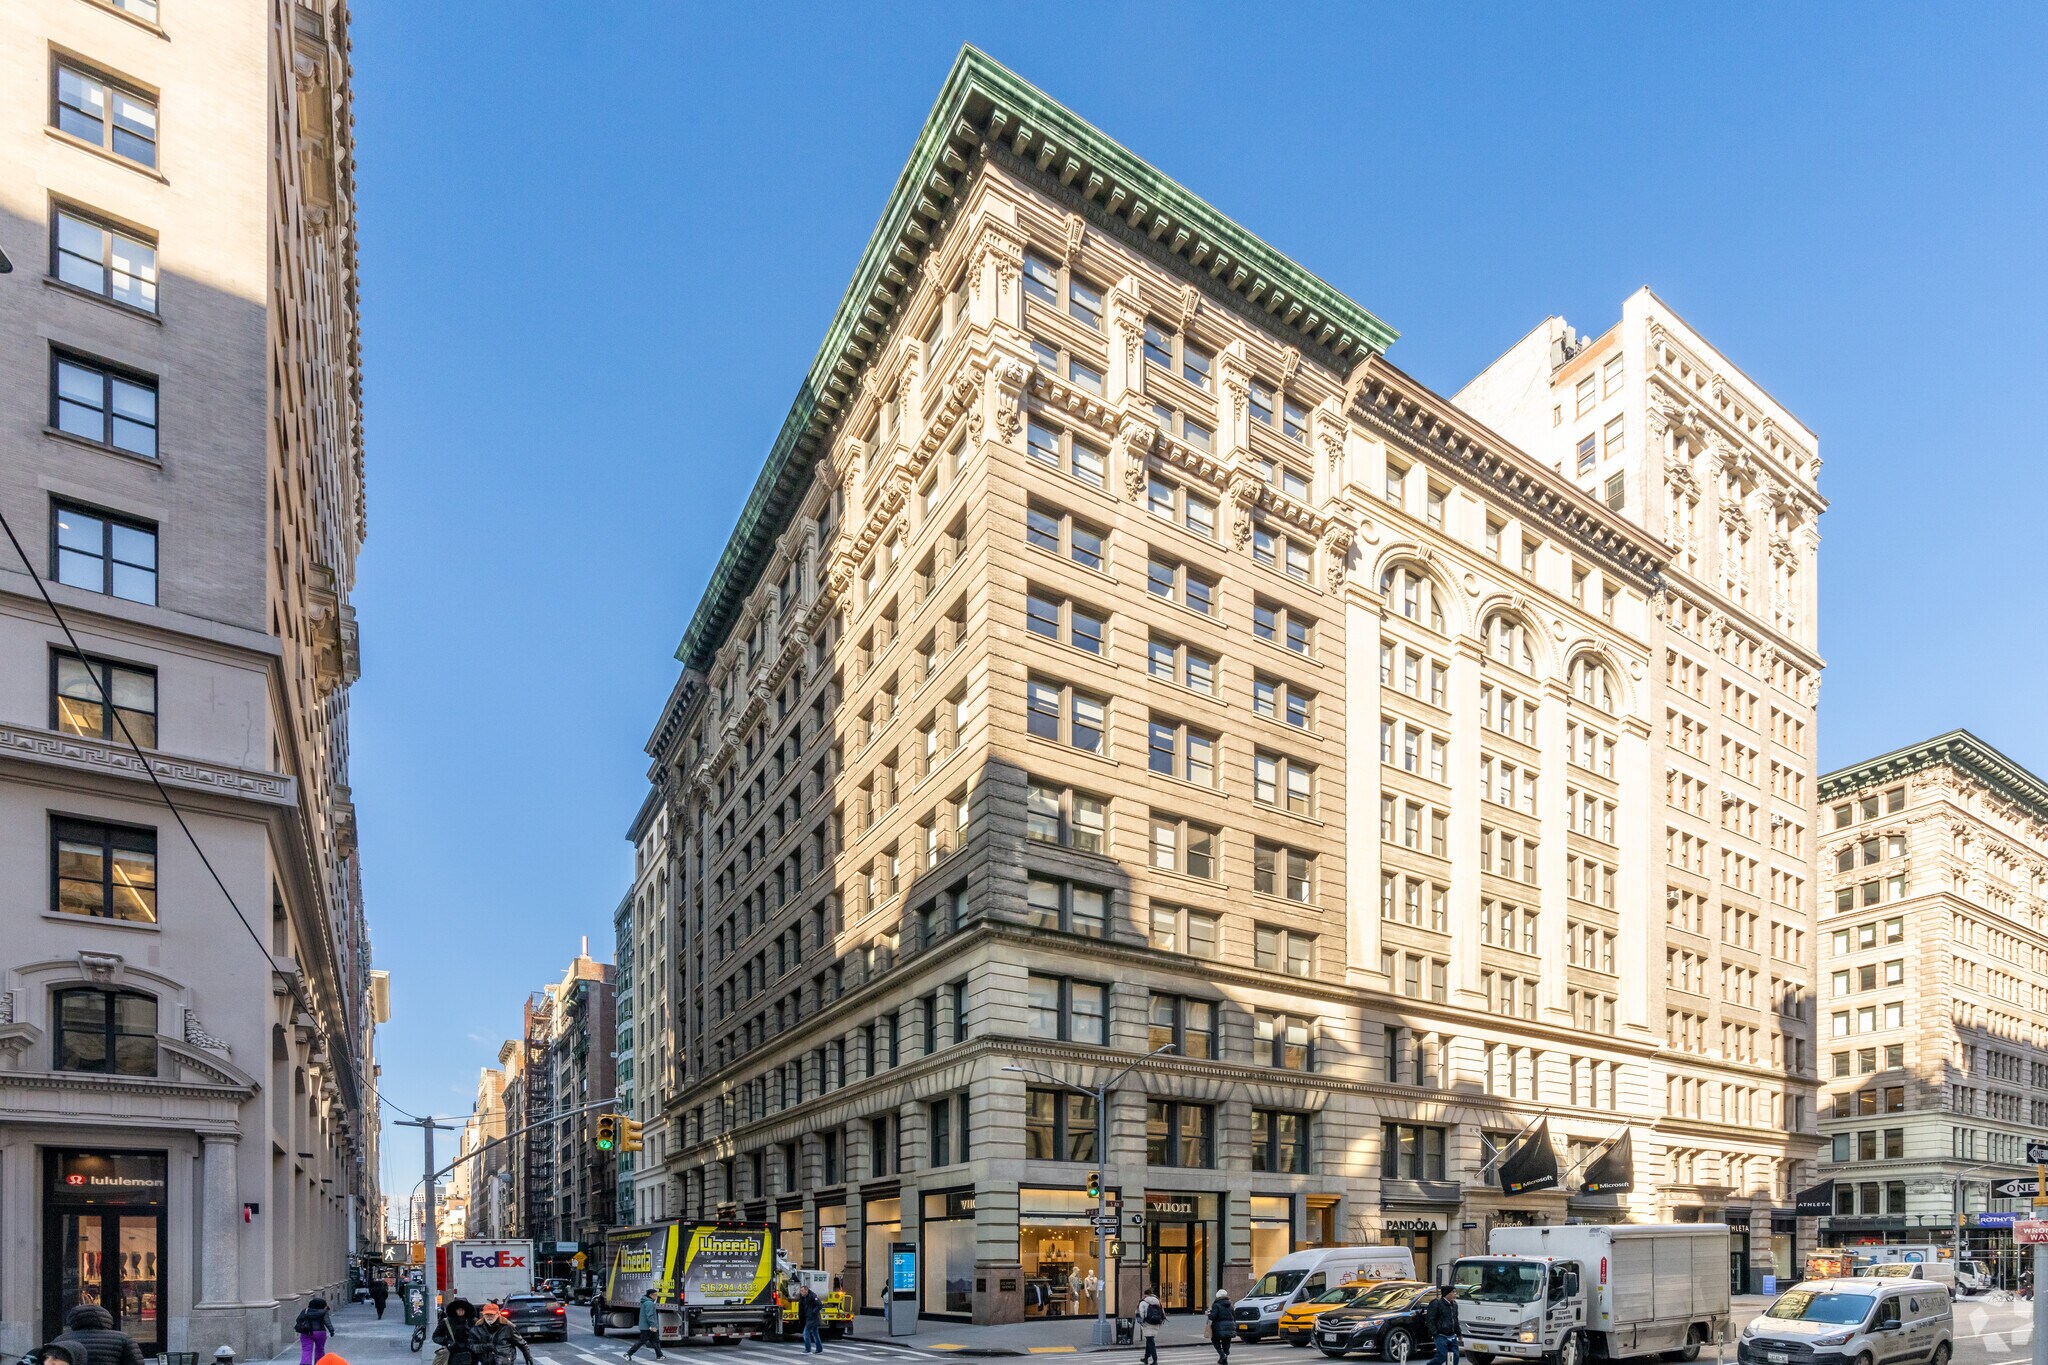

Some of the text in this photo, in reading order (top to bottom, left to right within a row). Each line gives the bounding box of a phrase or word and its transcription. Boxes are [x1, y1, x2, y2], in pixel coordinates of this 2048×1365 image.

[2032, 1150, 2044, 1158] ONE
[90, 1176, 164, 1186] lululemon
[1522, 1175, 1553, 1187] Microsoft
[2006, 1184, 2036, 1192] ONE
[1153, 1202, 1192, 1213] vuori
[699, 1236, 760, 1252] Uneeda
[461, 1251, 525, 1268] FedEx
[621, 1246, 652, 1273] Uneeda
[700, 1283, 758, 1292] 516.294.4333
